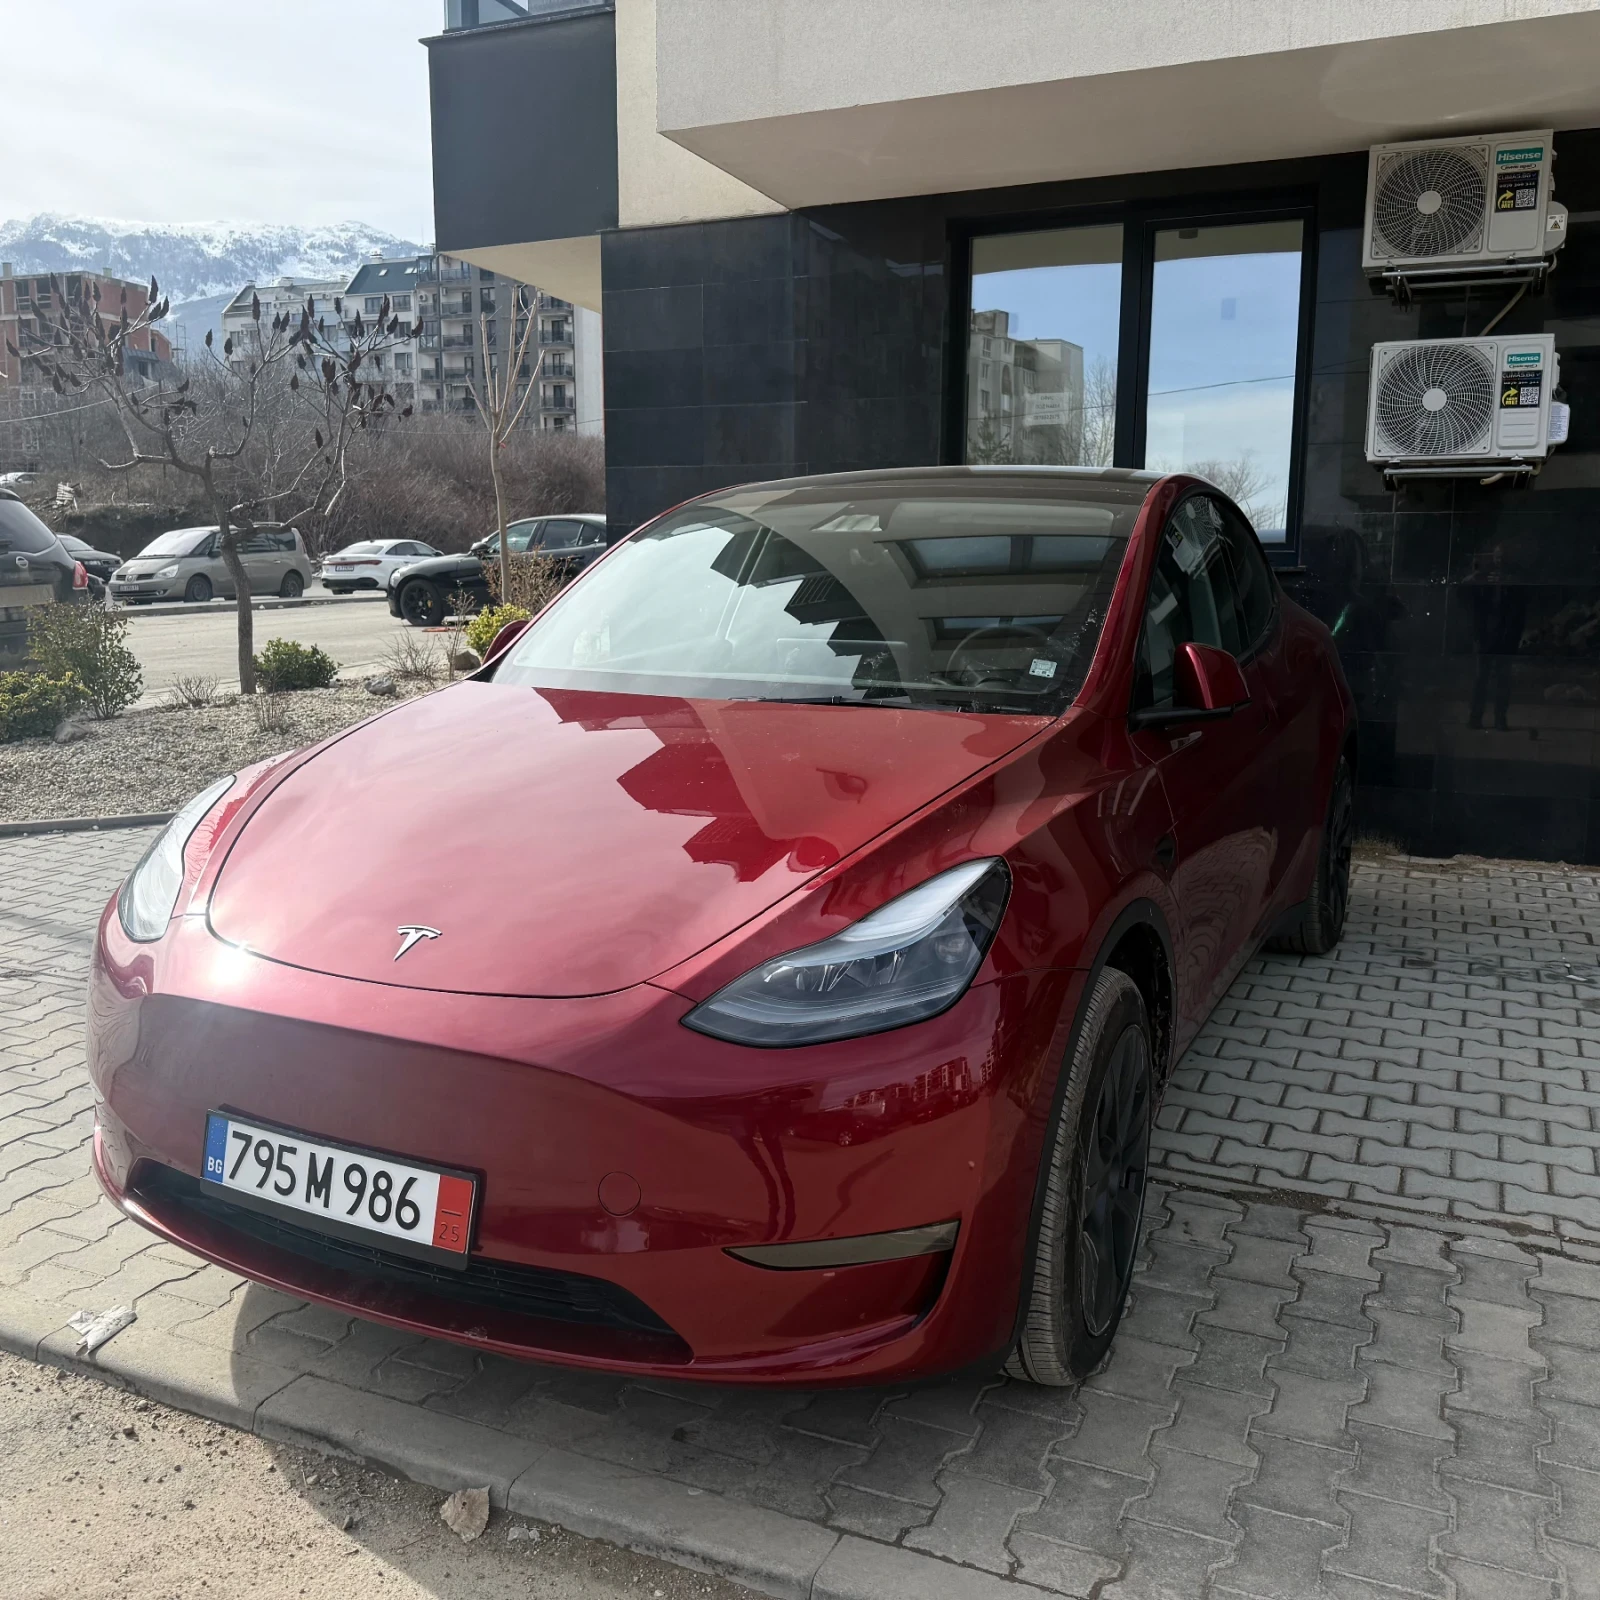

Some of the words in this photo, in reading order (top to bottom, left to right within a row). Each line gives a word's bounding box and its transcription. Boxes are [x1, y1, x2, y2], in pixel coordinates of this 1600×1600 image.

[1497, 152, 1541, 162] Hisense
[207, 1156, 223, 1174] BG
[228, 1130, 298, 1197] 795
[305, 1152, 334, 1209] M
[343, 1163, 421, 1231] 986
[439, 1221, 460, 1243] 25
